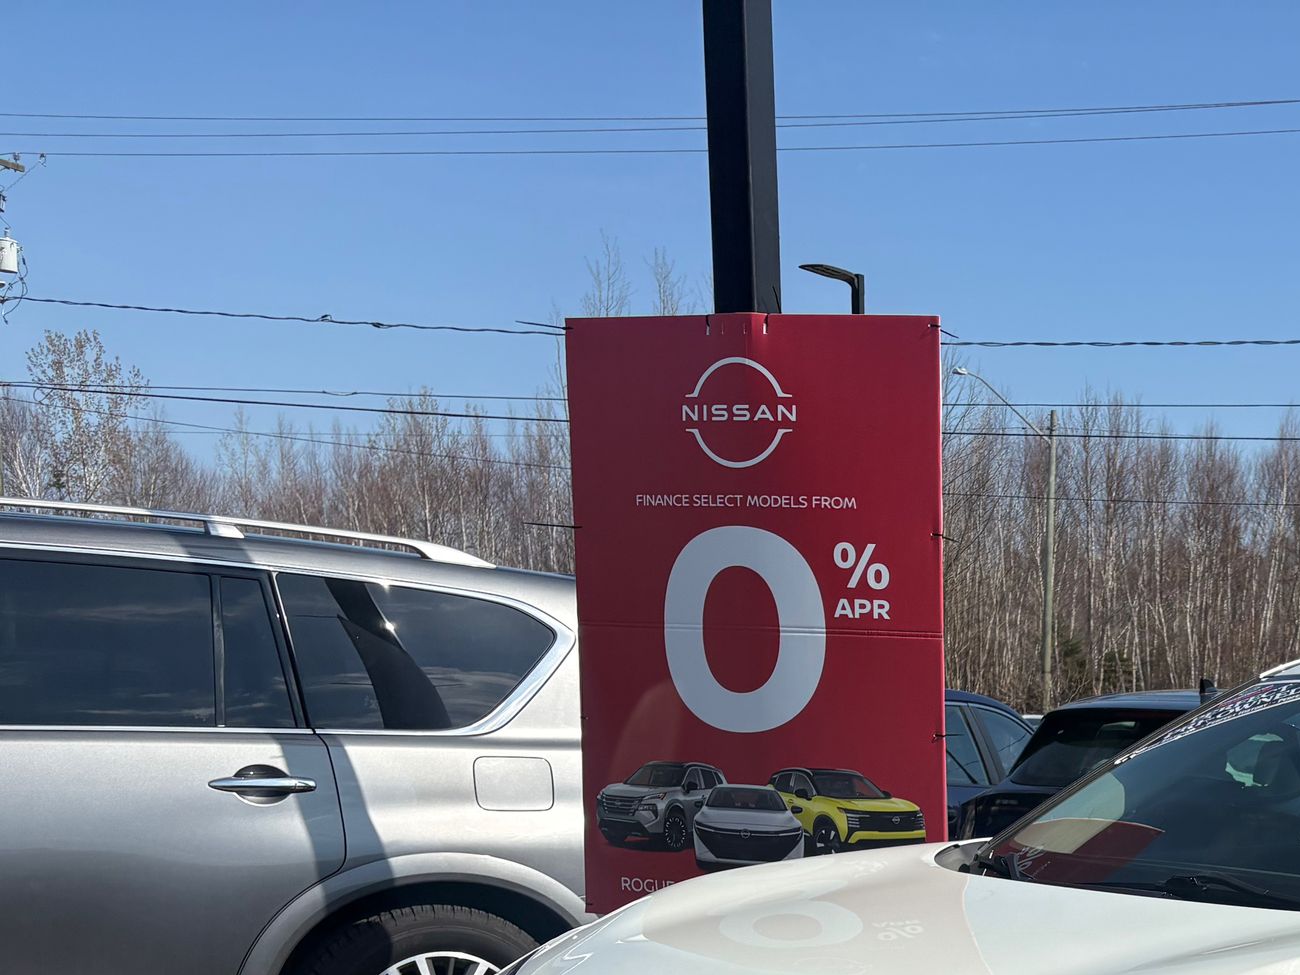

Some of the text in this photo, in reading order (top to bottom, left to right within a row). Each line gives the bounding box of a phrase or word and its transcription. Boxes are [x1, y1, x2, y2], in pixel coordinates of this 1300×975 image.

[681, 404, 797, 422] NISSAN
[635, 494, 858, 510] FINANCE SELECT MODELS FROM
[833, 541, 890, 590] %
[833, 598, 891, 620] APR
[664, 525, 827, 733] 0
[620, 876, 675, 893] ROGU
